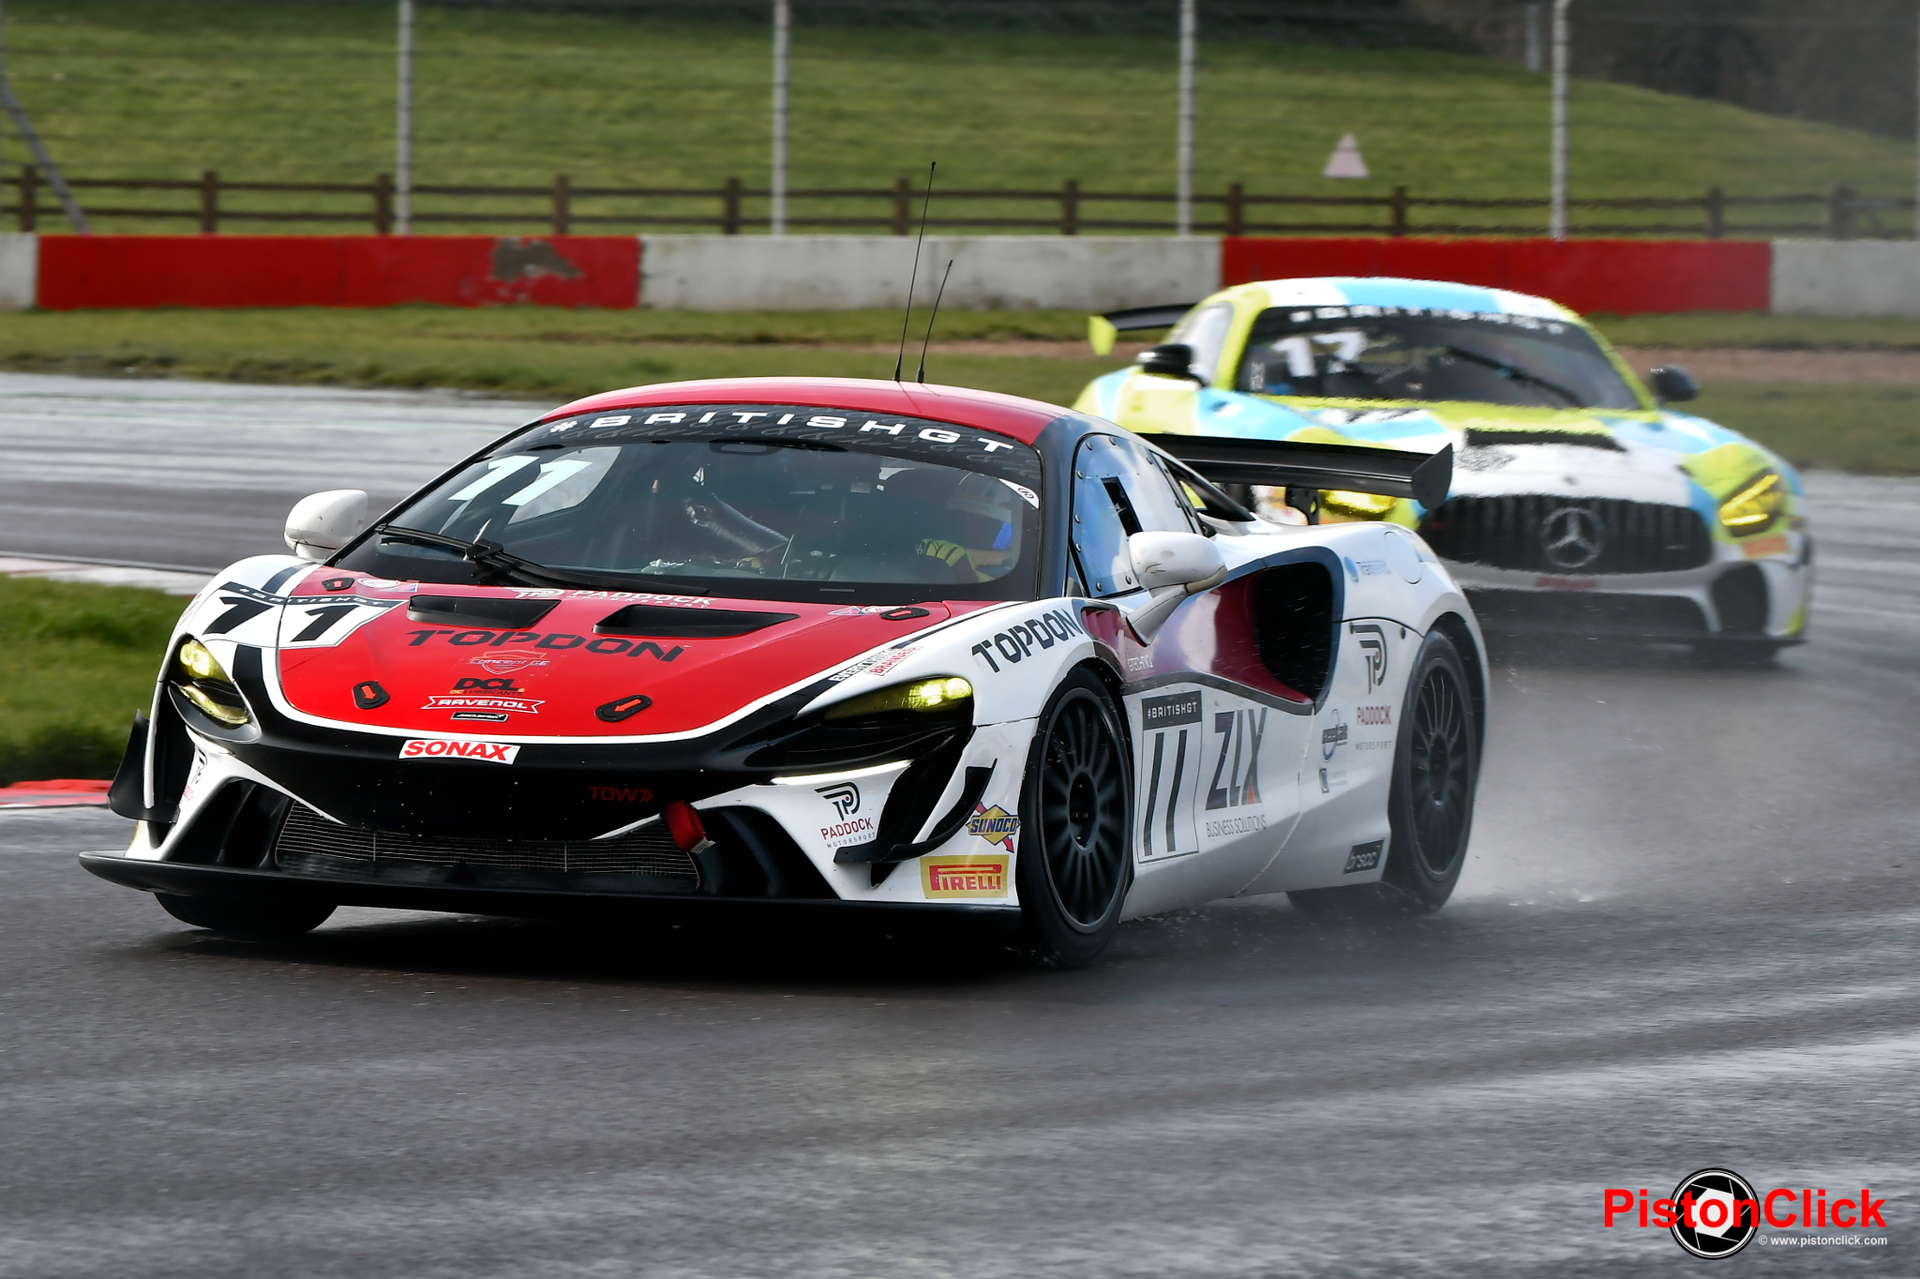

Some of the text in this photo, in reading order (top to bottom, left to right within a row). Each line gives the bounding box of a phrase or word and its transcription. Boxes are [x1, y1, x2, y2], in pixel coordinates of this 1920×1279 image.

[550, 411, 1015, 453] #BRITISHGT
[447, 455, 593, 506] 11
[571, 590, 718, 606] PADDOCK
[202, 596, 361, 643] 11
[405, 630, 685, 663] TOPDON
[971, 608, 1084, 673] TOPDON
[453, 677, 521, 692] DCL
[437, 698, 529, 710] RAVENOL
[1147, 701, 1198, 719] #BRITISHGT
[404, 740, 512, 762] SONAX
[589, 785, 639, 802] TOW
[1144, 729, 1188, 857] 11
[820, 817, 874, 841] PADDOCK
[969, 816, 1018, 834] SUNOCO
[1206, 819, 1235, 838] BUSINESS
[826, 831, 877, 849] MOTORSPORT
[929, 864, 1003, 892] PIRELLI
